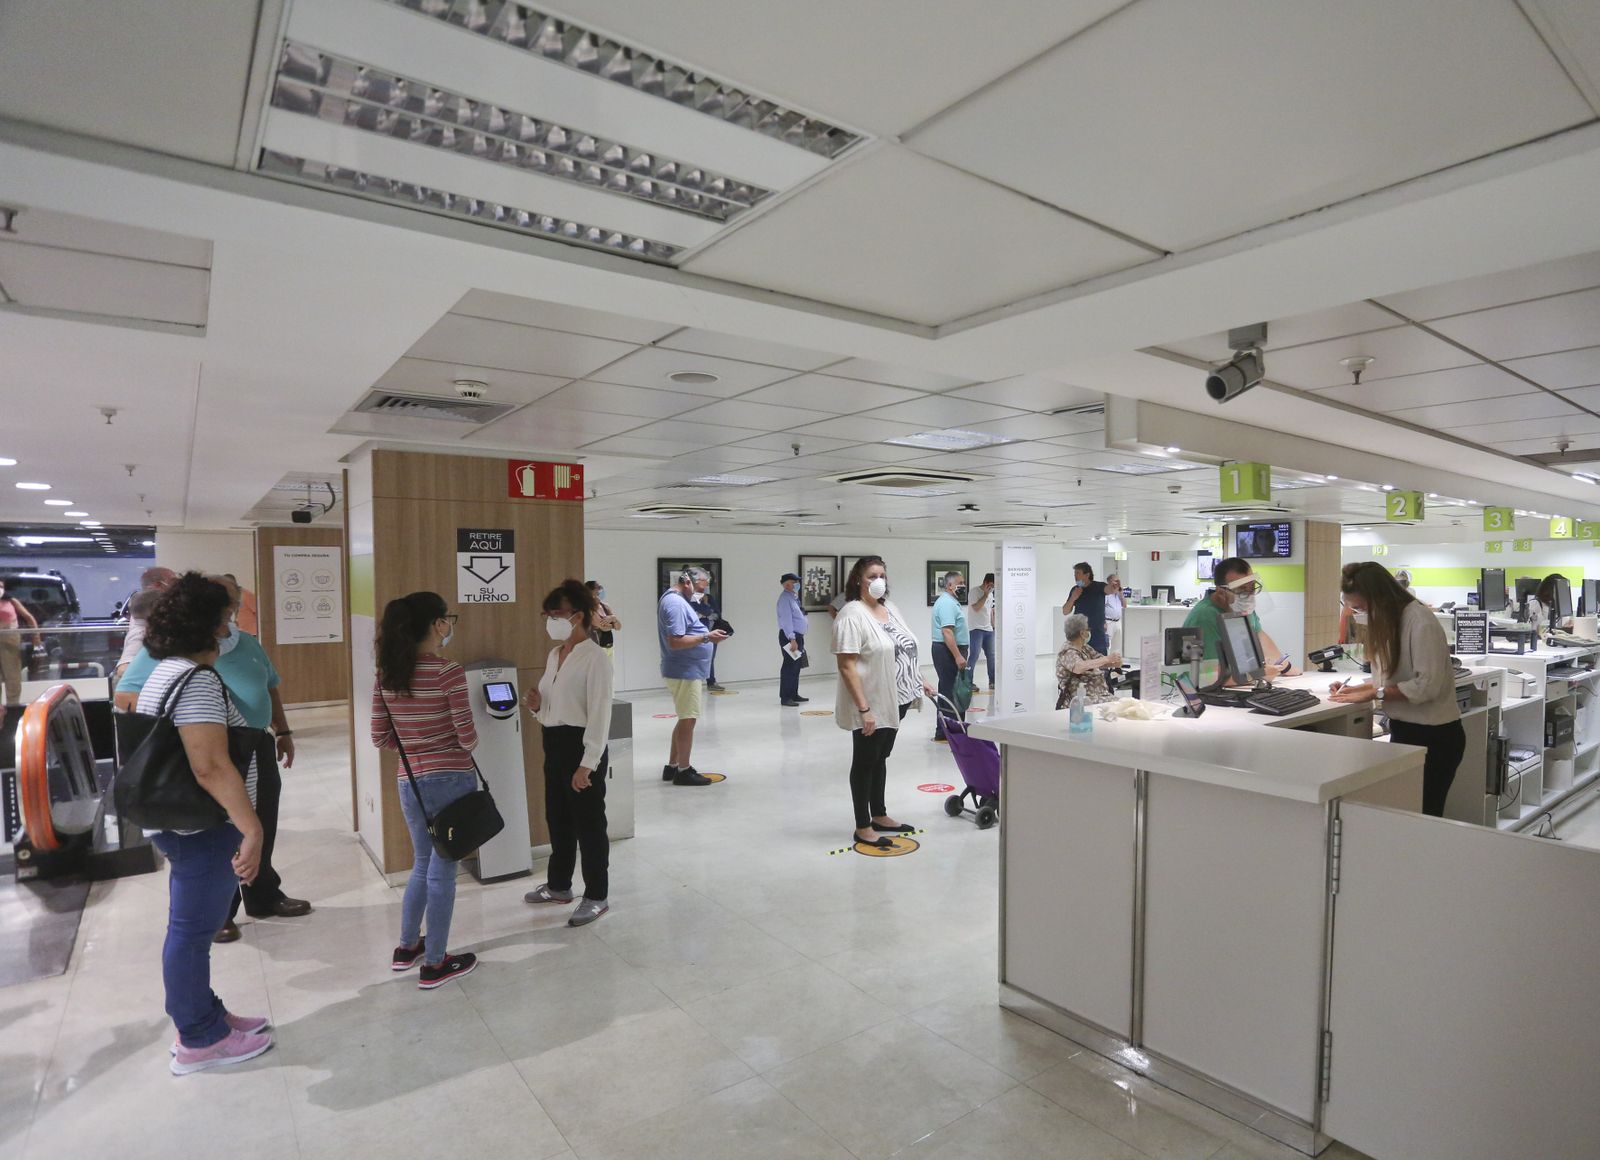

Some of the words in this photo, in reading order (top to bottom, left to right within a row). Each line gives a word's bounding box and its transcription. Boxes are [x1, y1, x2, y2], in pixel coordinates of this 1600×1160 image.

[1229, 470, 1239, 494] 1
[1392, 496, 1406, 515] 2
[1490, 512, 1502, 528] 3
[1555, 521, 1567, 535] 4
[1583, 526, 1592, 538] 5
[469, 532, 503, 540] RETIRE
[469, 539, 502, 550] AQUÍ
[1494, 543, 1501, 552] 9
[1523, 541, 1529, 550] 8
[464, 594, 510, 602] TURNO
